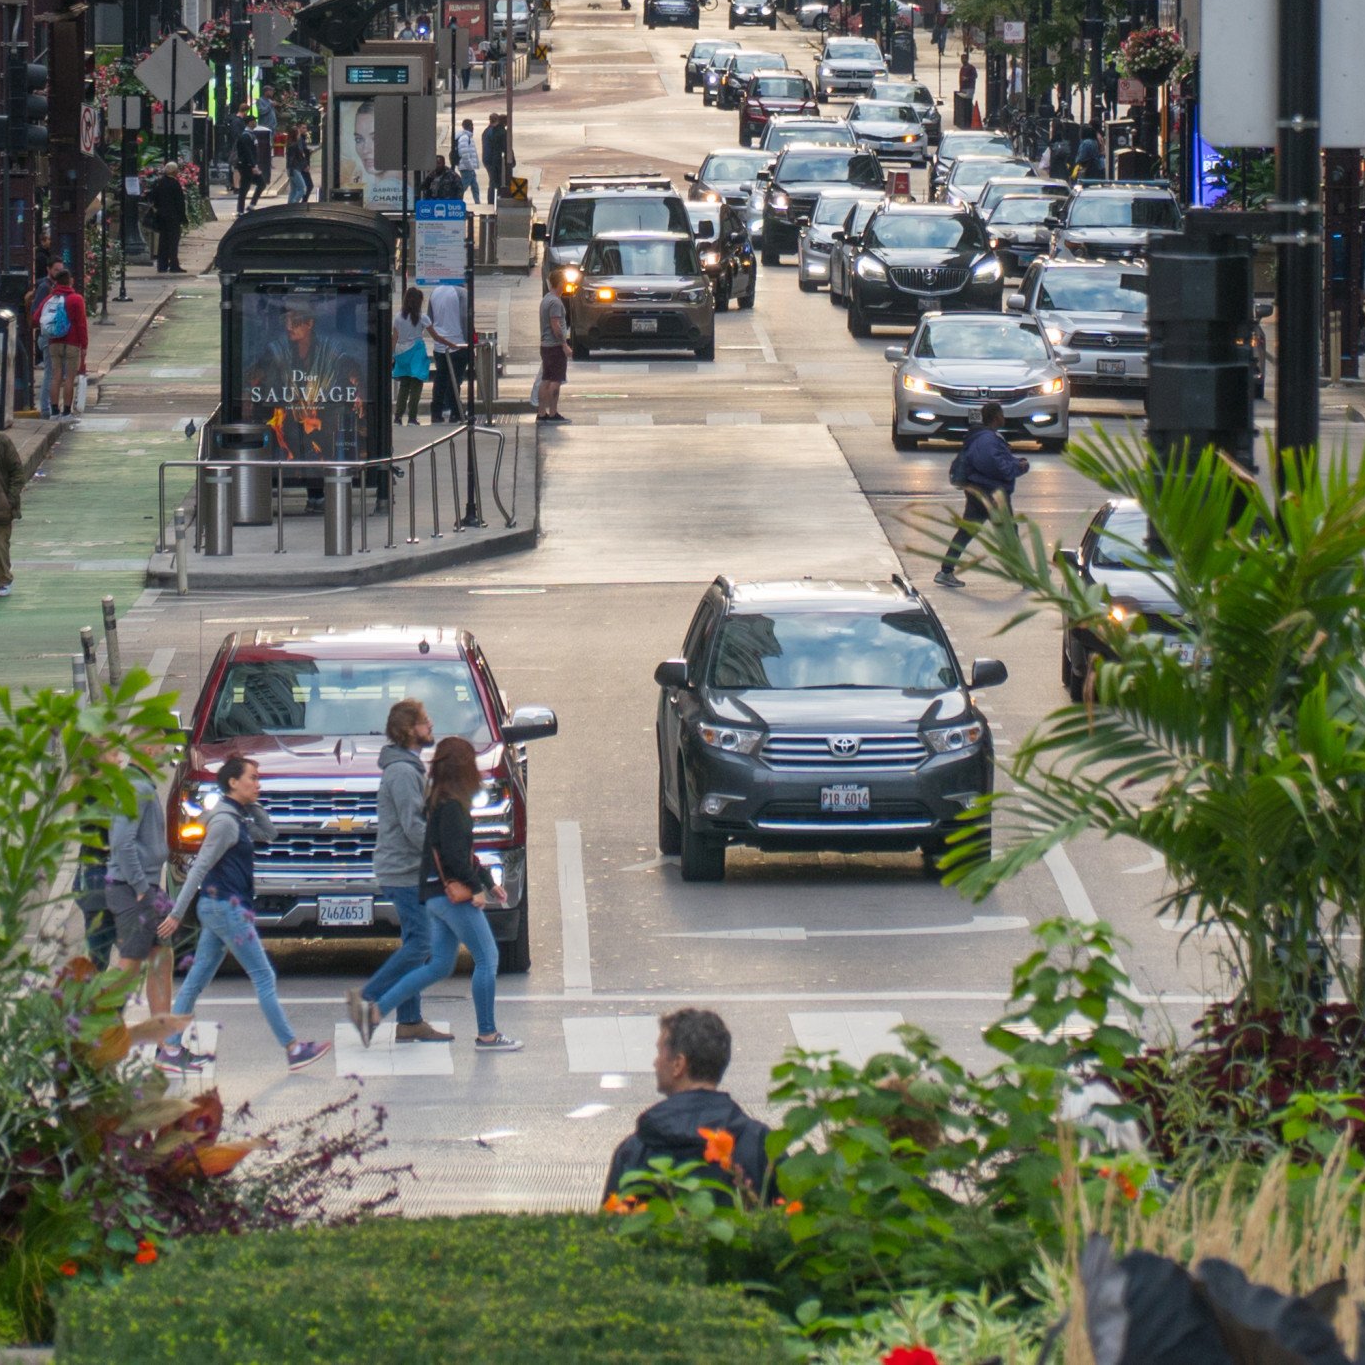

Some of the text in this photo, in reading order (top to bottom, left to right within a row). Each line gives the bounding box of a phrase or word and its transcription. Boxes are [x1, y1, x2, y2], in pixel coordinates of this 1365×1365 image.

[448, 210, 465, 218] stop
[292, 370, 318, 382] Dior
[251, 386, 357, 403] SAUVAGE
[321, 907, 364, 920] 2462653
